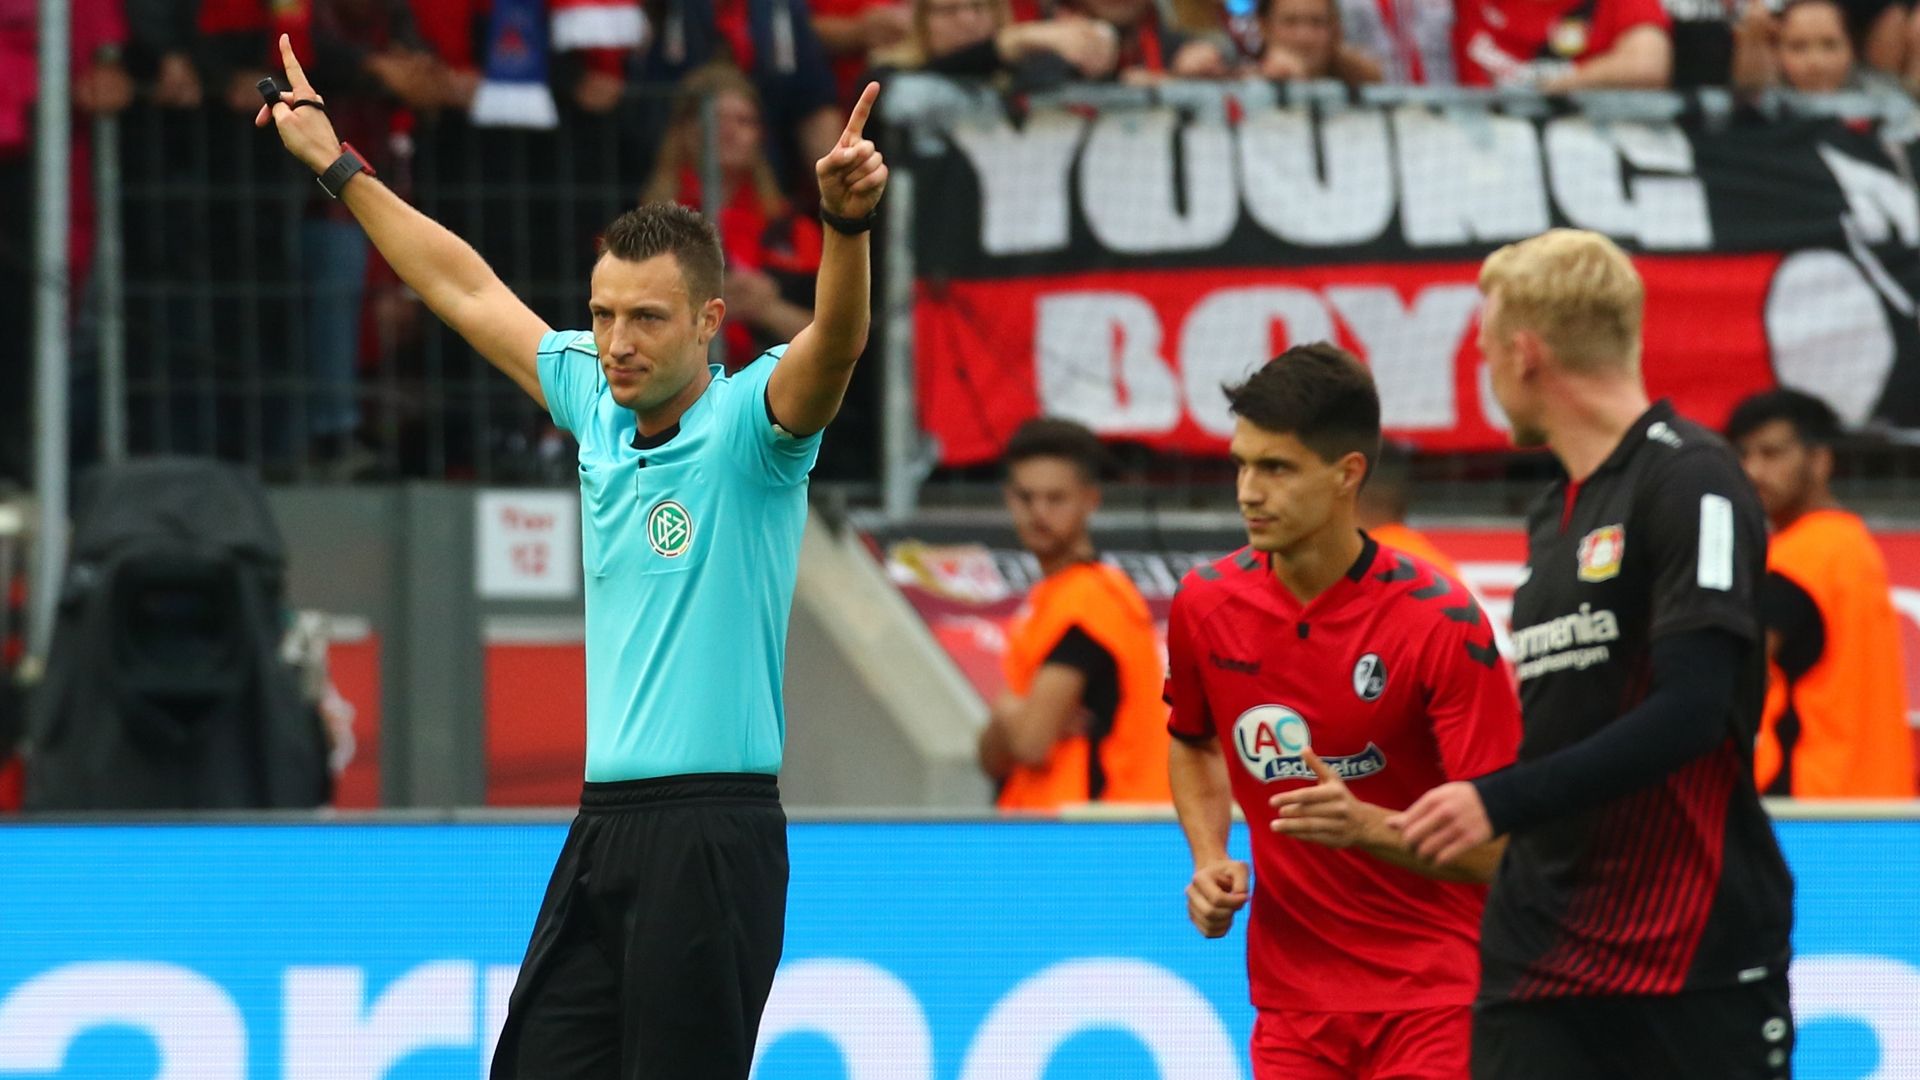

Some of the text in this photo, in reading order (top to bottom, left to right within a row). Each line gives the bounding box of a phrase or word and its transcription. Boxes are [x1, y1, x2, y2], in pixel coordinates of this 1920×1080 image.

[948, 106, 1714, 256] YOUNG
[1034, 282, 1512, 438] BOY
[1239, 716, 1308, 763] LAC
